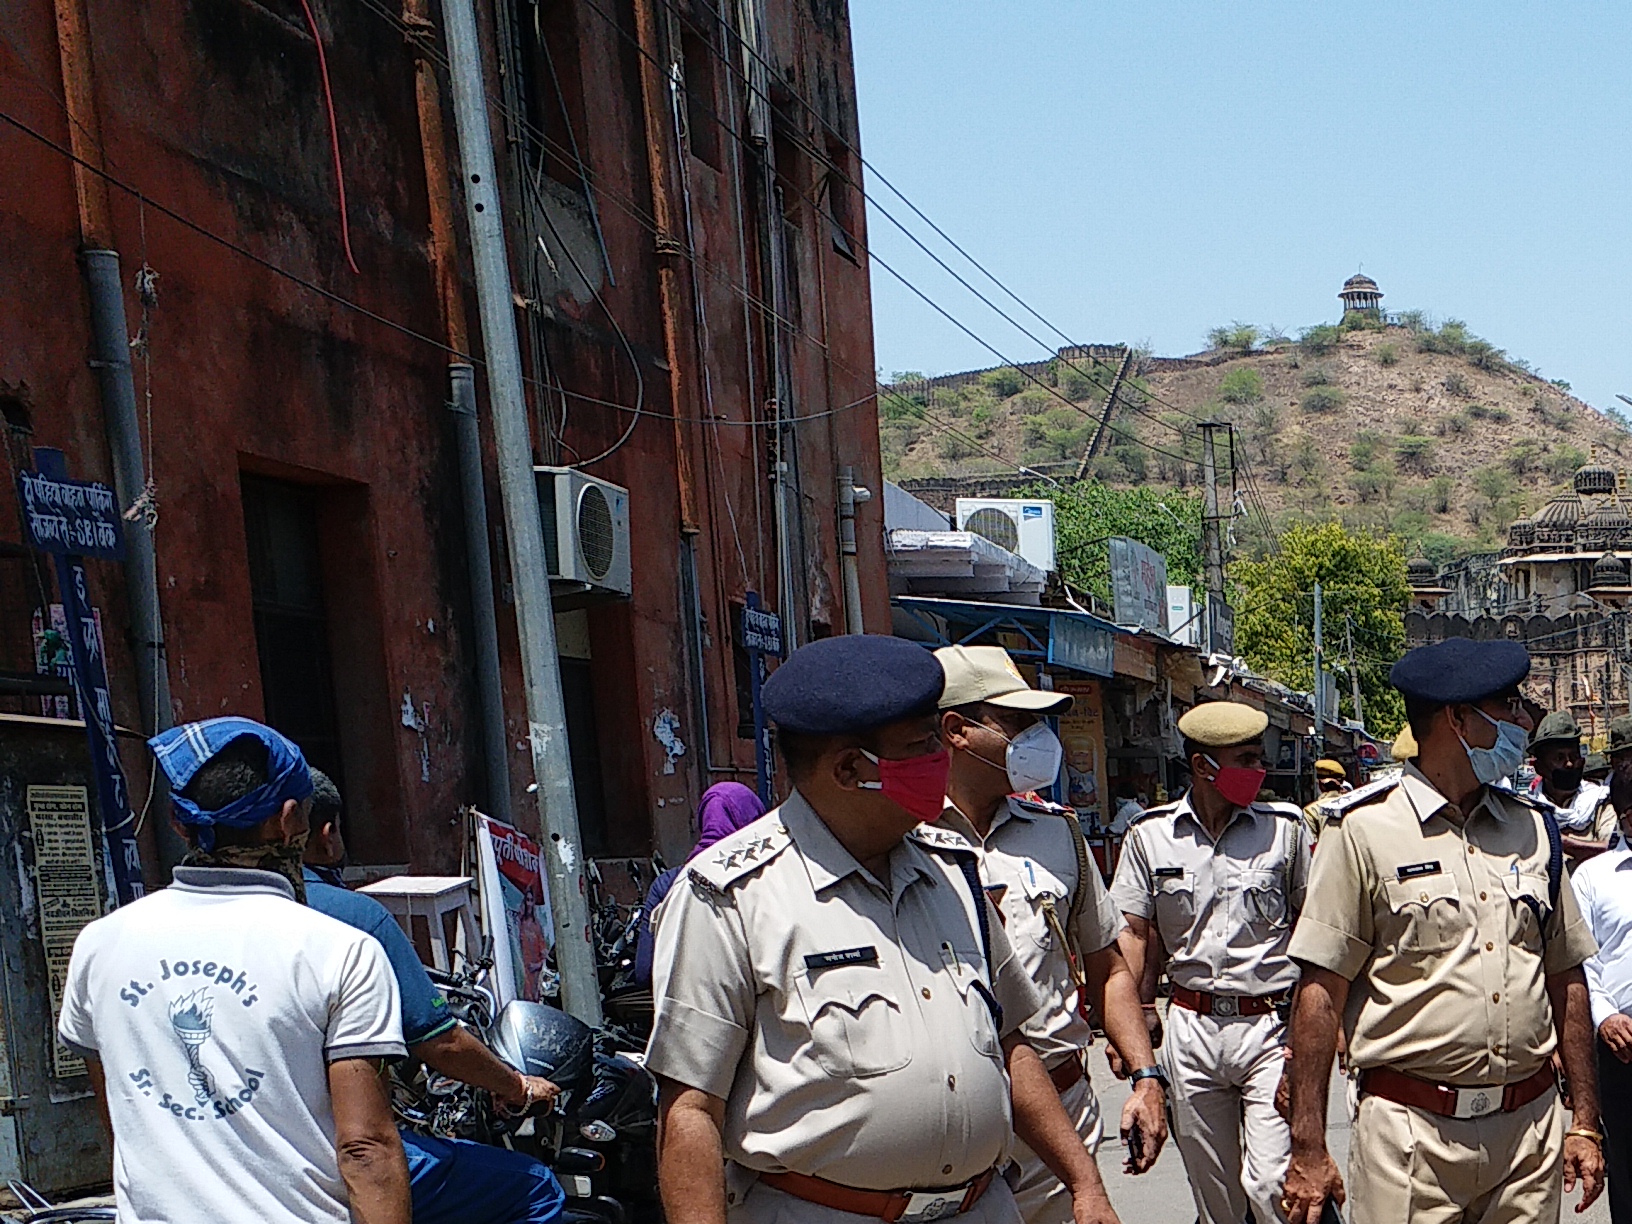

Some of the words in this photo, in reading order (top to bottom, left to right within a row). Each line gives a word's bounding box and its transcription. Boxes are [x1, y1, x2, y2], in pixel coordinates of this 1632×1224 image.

[60, 482, 86, 517] वाहन
[75, 518, 99, 547] SBI
[120, 979, 155, 1008] St.
[159, 958, 259, 1008] Joseph's
[128, 1067, 154, 1097] Sr.
[157, 1092, 206, 1121] Sec.
[213, 1067, 265, 1120] School
